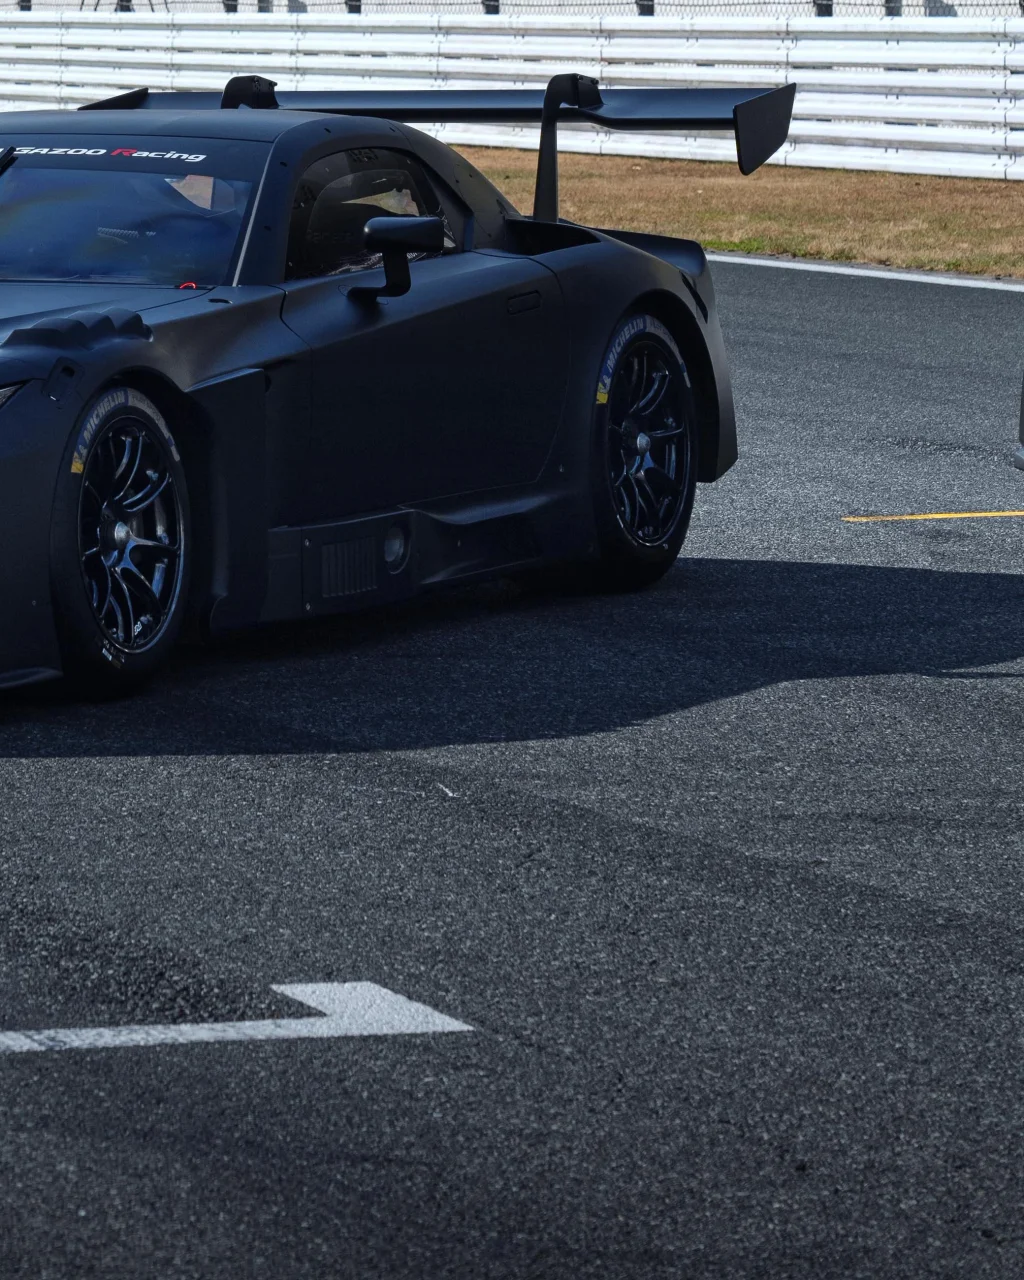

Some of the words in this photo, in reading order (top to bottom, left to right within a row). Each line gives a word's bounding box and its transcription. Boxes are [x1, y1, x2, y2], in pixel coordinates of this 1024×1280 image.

[12, 146, 107, 156] GAZOO
[110, 147, 208, 163] Racing
[607, 317, 644, 373] MICHELIN
[83, 390, 126, 445] MICHELIN
